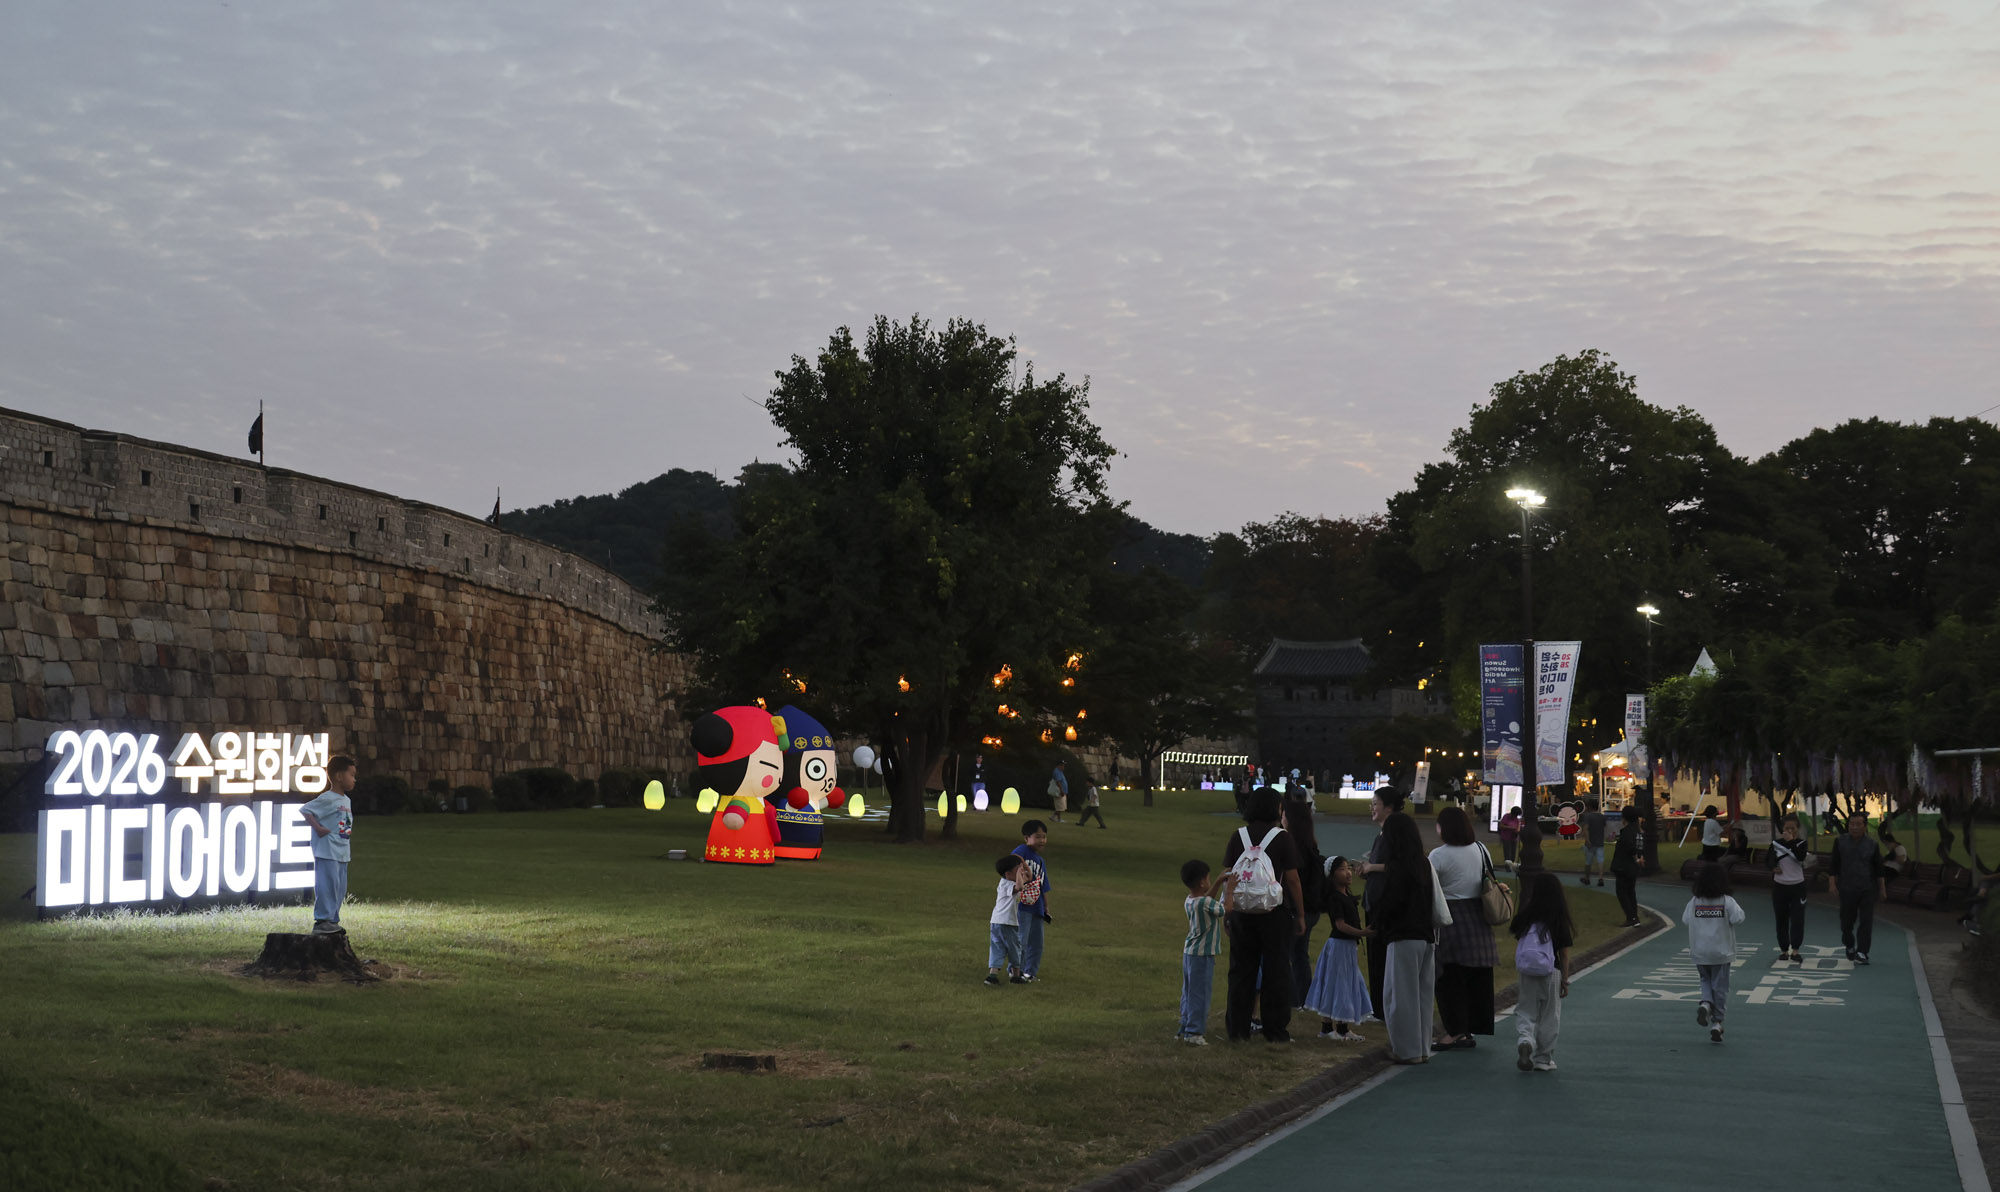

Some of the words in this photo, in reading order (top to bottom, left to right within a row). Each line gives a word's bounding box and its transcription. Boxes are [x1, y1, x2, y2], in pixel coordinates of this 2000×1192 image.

[47, 729, 166, 797] 2026
[168, 731, 329, 794] 수원화성
[37, 801, 316, 907] 미디어아트
